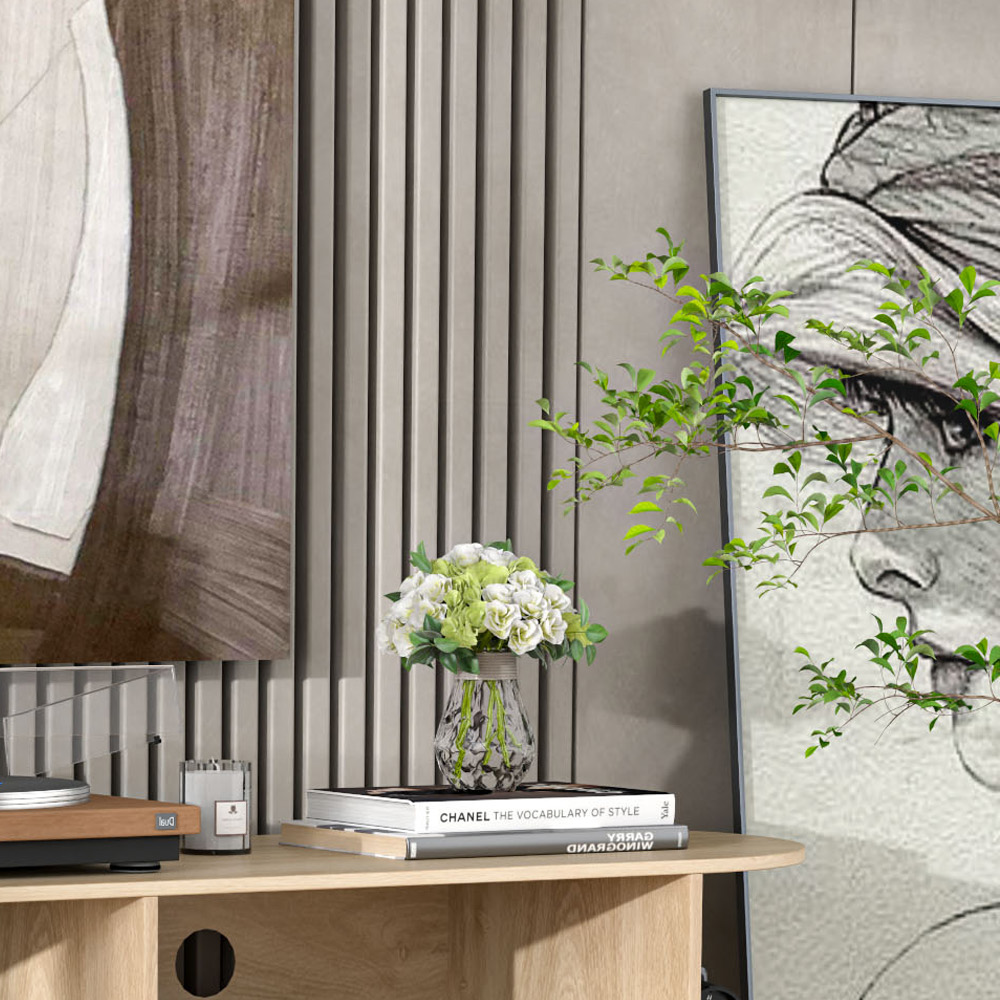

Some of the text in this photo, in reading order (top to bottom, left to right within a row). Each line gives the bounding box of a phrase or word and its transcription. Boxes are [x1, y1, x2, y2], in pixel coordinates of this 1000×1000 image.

[440, 806, 640, 823] CHANEL THE VOCABULARY OF STYLE
[661, 801, 669, 820] Yale
